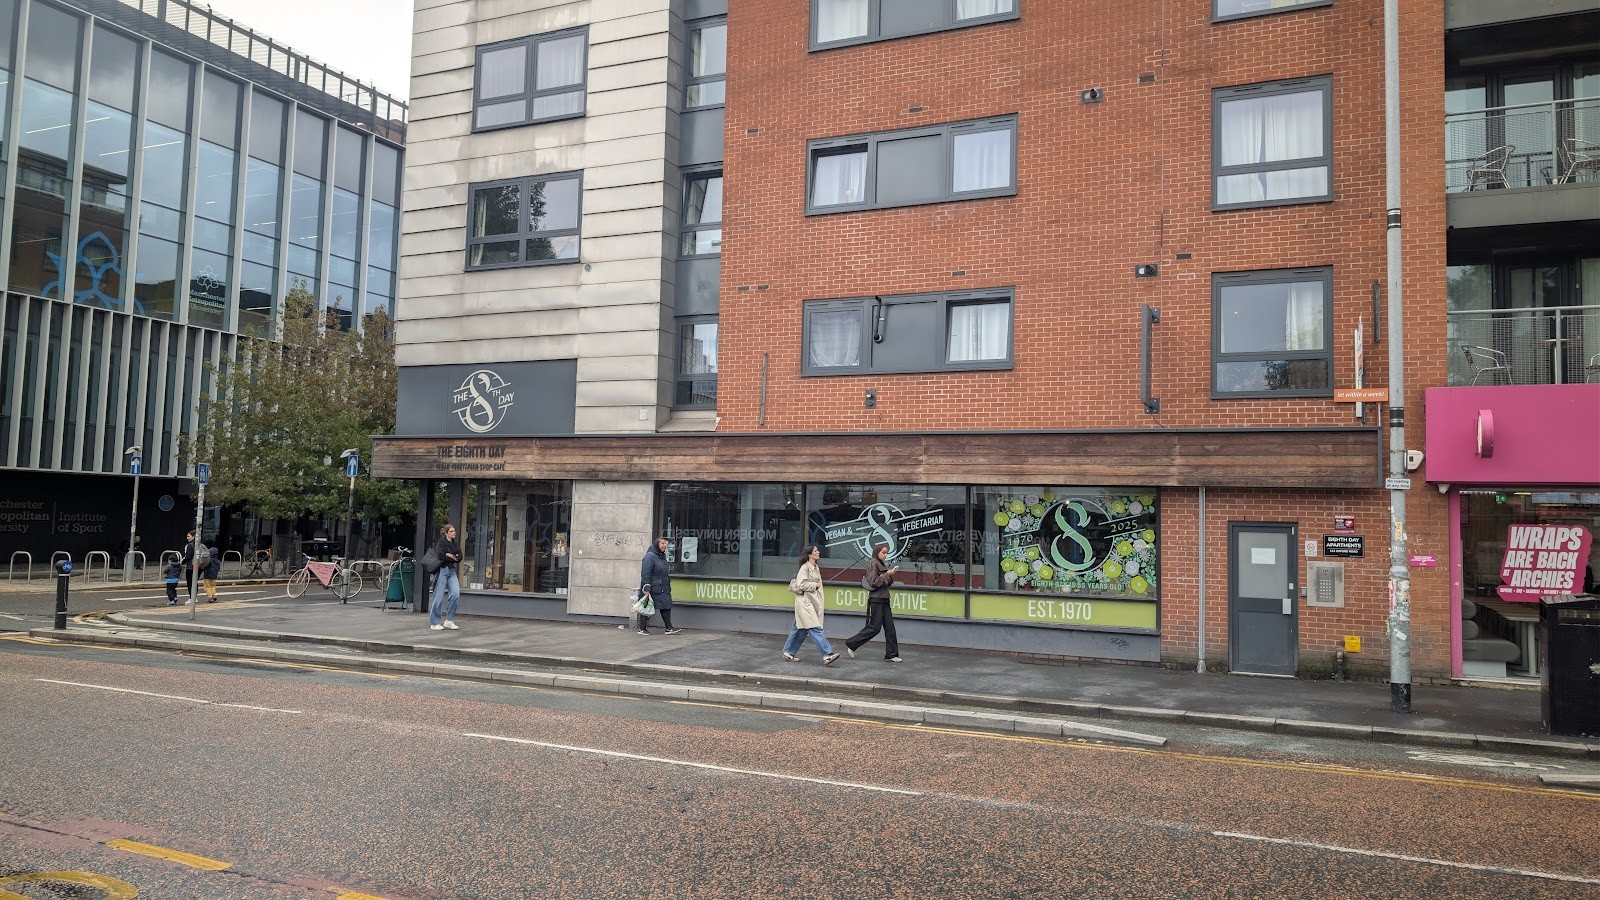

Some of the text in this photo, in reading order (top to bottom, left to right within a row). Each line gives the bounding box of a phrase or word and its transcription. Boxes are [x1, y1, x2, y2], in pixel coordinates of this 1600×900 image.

[453, 391, 469, 404] THE
[498, 391, 515, 405] DAY
[437, 445, 507, 458] THE EIGHTH DAY
[59, 512, 107, 522] Institute
[902, 514, 944, 532] VEGETARIAN
[57, 523, 104, 535] of Sport
[1110, 519, 1138, 533] 2025
[825, 527, 846, 540] VEGAN
[1007, 534, 1033, 547] 1970
[1509, 526, 1583, 550] WRAPS
[1504, 550, 1579, 570] ARE BACK
[1087, 582, 1108, 590] YEARS
[1509, 569, 1575, 589] ARCHIES
[695, 582, 757, 601] WORKERS'
[836, 589, 927, 611] CO-OATIVE
[1028, 600, 1092, 621] EST. 1970
